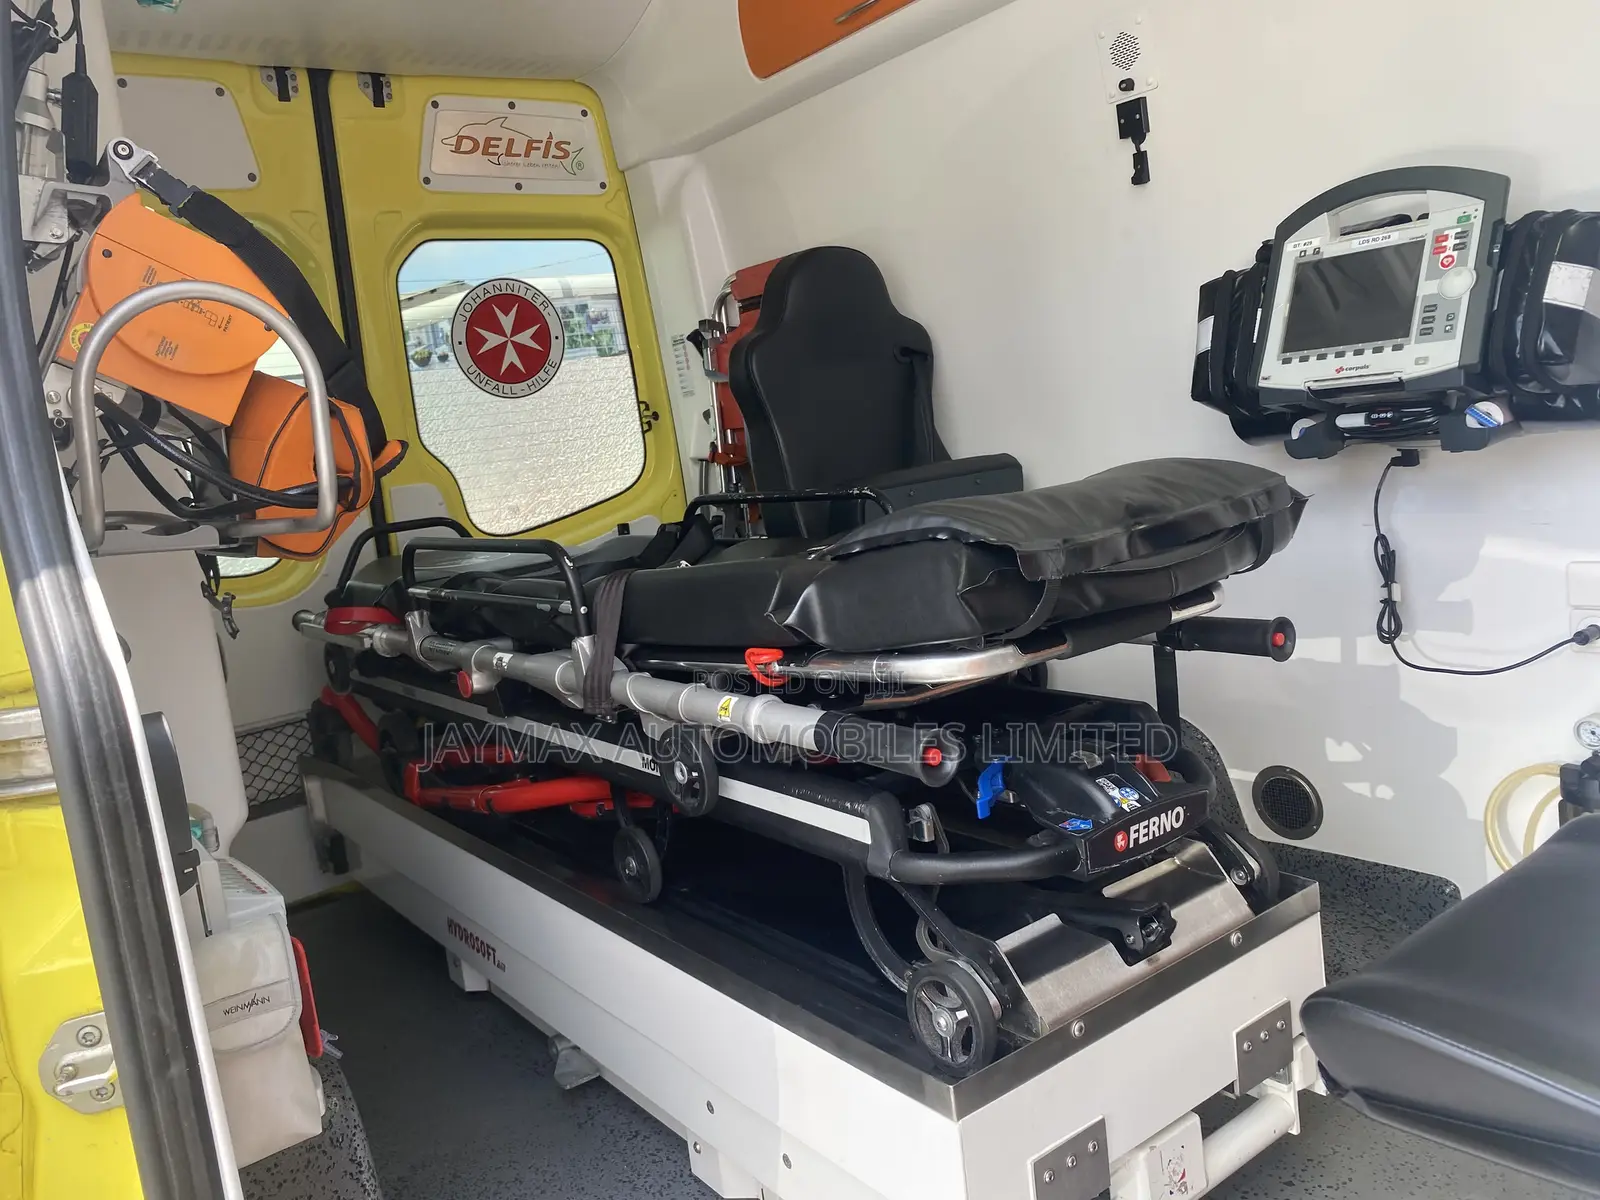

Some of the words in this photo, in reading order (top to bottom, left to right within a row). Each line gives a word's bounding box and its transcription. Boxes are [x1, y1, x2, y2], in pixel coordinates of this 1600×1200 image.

[1345, 364, 1370, 372] corpuls
[1129, 806, 1185, 850] FERNO
[446, 916, 497, 966] HYDROSOFT
[222, 992, 271, 1016] WEINMANN
